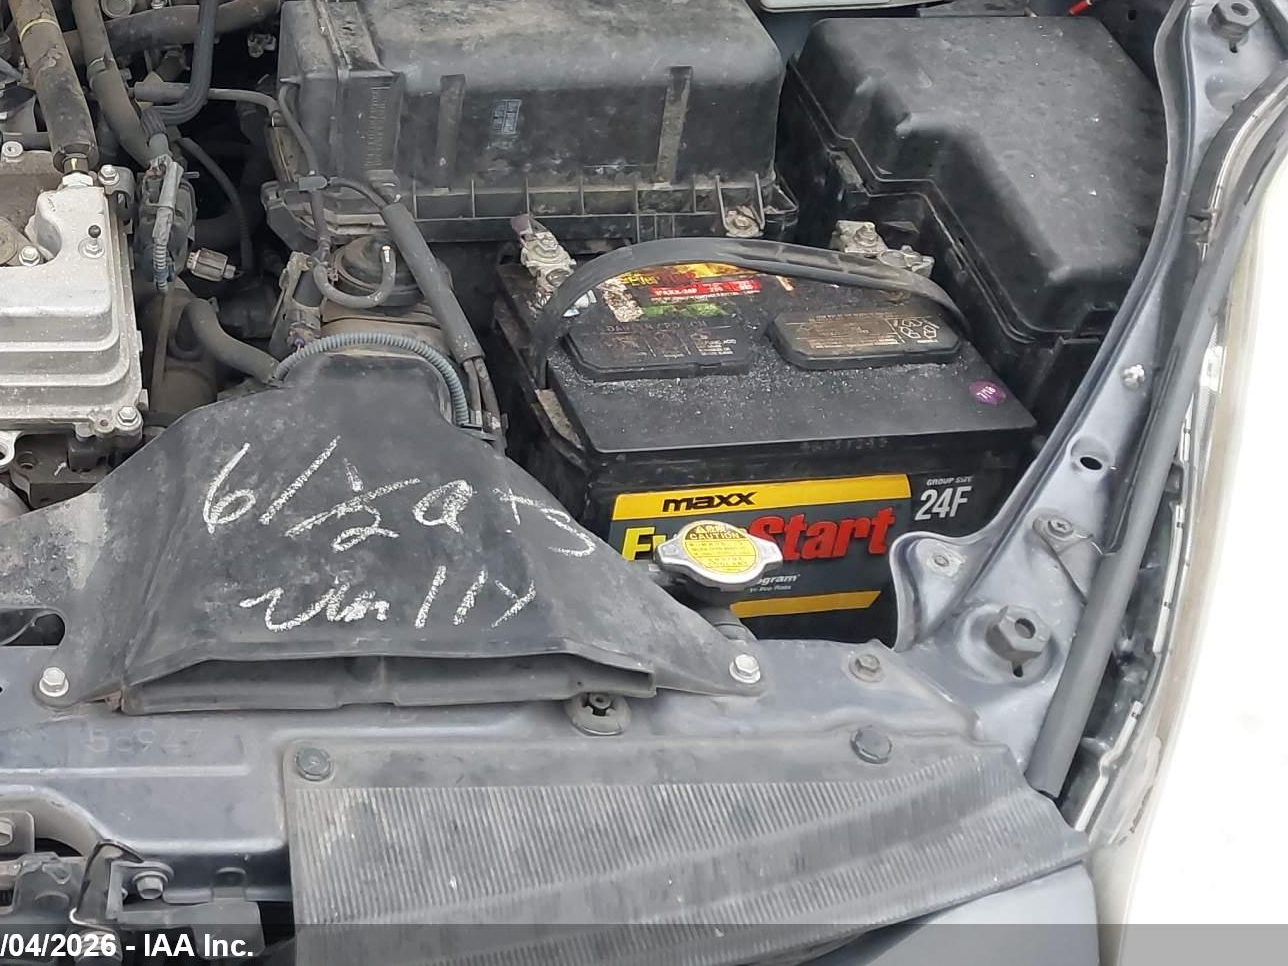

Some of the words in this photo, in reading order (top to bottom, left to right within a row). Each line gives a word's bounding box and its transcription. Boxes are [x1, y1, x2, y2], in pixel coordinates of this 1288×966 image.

[926, 478, 955, 487] GROUP
[662, 491, 758, 513] maxx
[914, 486, 972, 521] 24F
[689, 532, 740, 540] CAUTION
